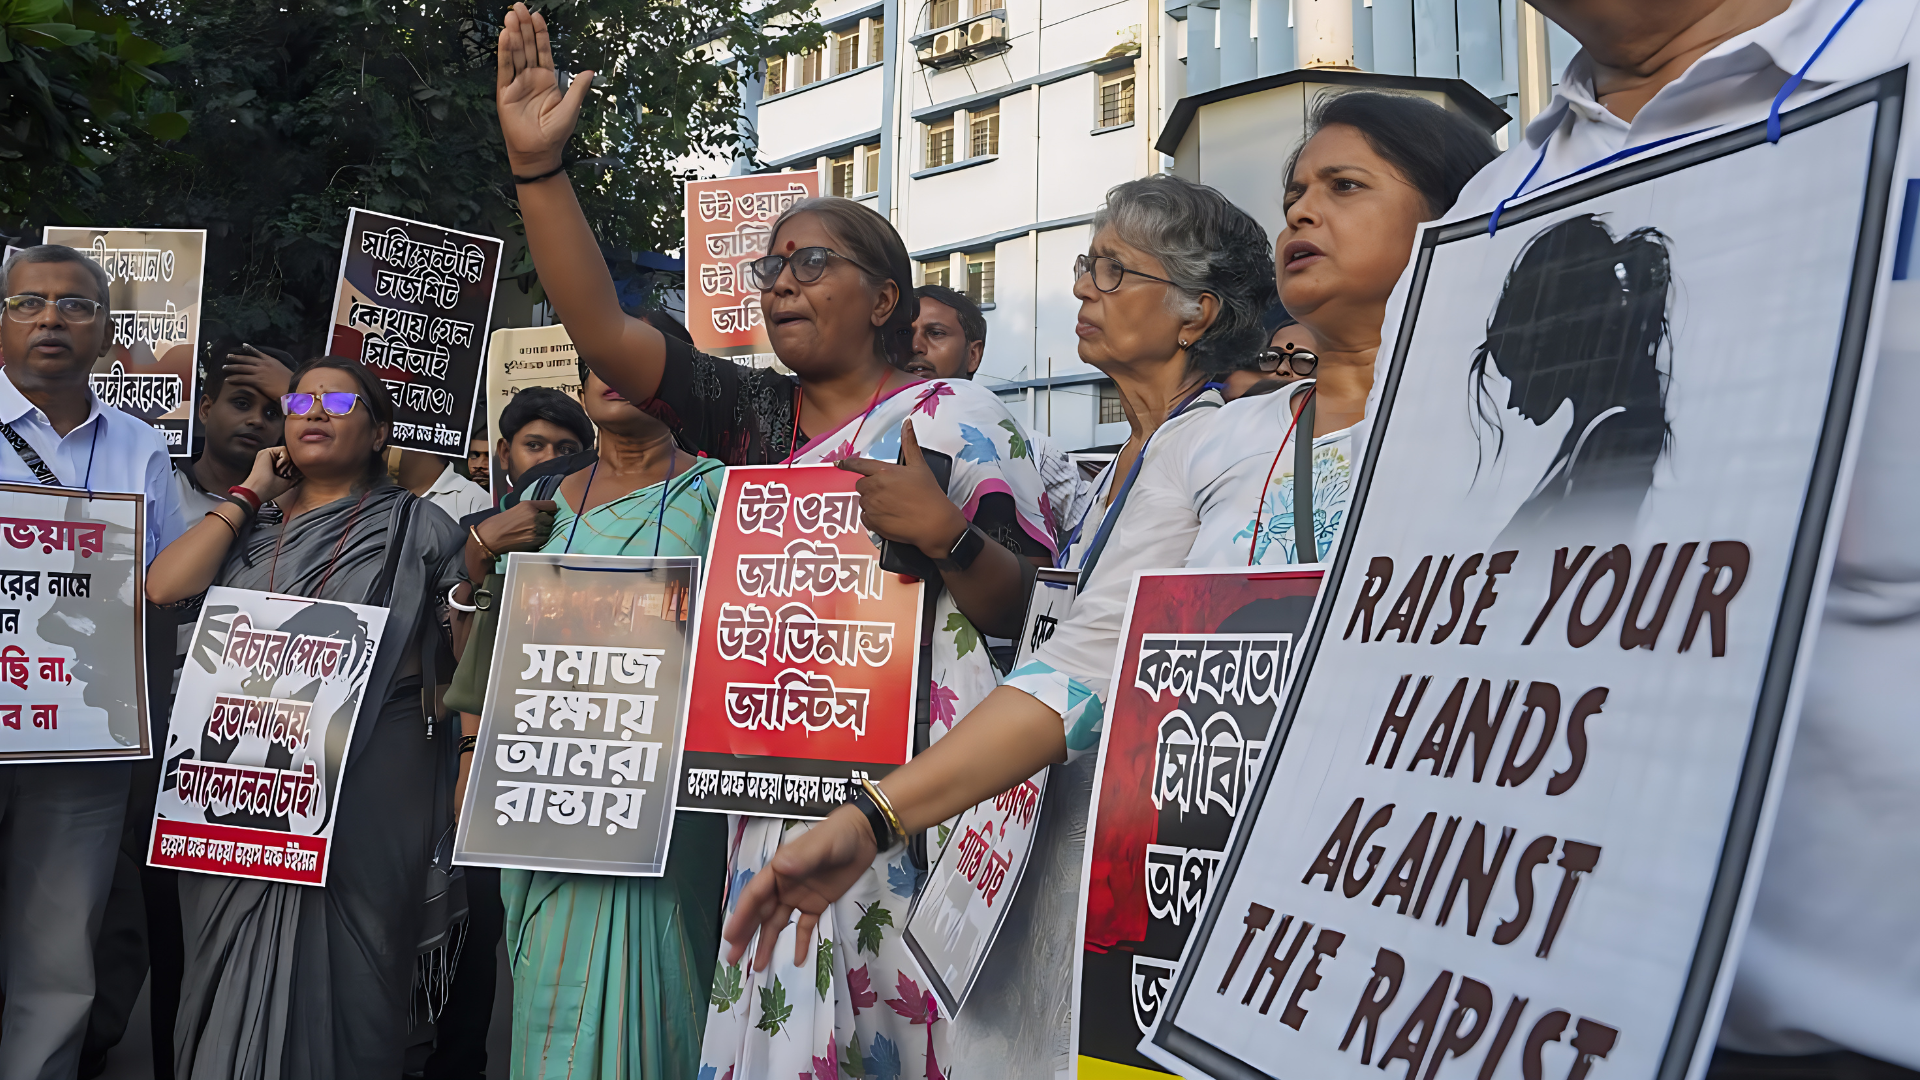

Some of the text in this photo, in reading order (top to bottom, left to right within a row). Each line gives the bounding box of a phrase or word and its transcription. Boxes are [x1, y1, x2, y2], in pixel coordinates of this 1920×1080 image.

[699, 190, 734, 222] উই
[0, 517, 106, 558] ভয়ার
[737, 481, 791, 538] উই
[48, 572, 91, 598] নামে
[1342, 541, 1751, 657] RAISE YOUR
[717, 601, 895, 667] উই ডিমান্ড
[521, 643, 665, 689] সমাজ
[1134, 633, 1293, 707] কলকাতা
[31, 704, 58, 730] না
[514, 688, 659, 741] রক্ষায়
[725, 667, 870, 741] জাস্টিস
[495, 734, 663, 785] আমরা
[1365, 674, 1610, 796] HANDS
[1151, 709, 1265, 823] সিবি
[494, 780, 646, 836] রাস্তায়
[1301, 797, 1602, 959] AGAINST
[1216, 902, 1346, 1031] THE
[1338, 947, 1621, 1080] RAPIST
